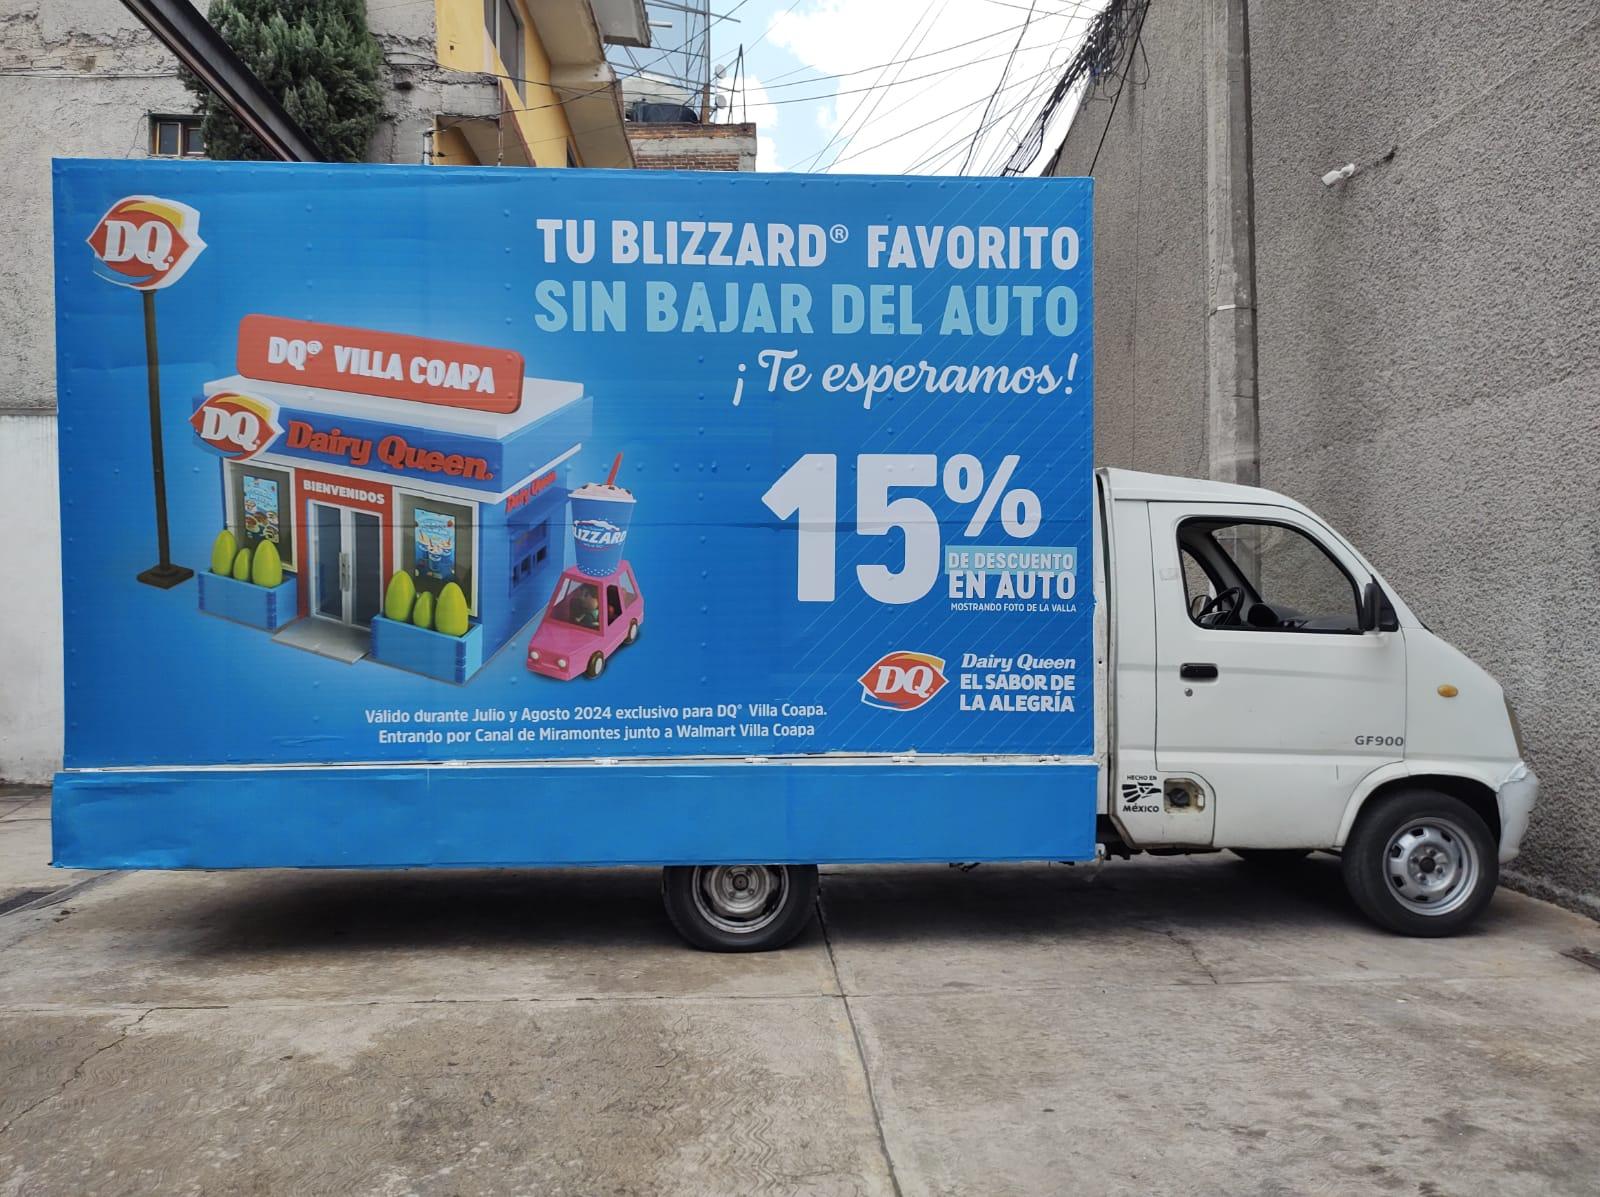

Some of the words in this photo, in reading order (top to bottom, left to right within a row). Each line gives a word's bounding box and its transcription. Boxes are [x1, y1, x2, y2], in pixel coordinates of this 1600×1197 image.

[536, 219, 596, 264] TU
[867, 225, 1080, 270] FAVORITO
[534, 280, 626, 332] SIN
[646, 281, 814, 334] BAJAR
[832, 284, 923, 335] DEL
[939, 286, 1079, 337] AUTO
[334, 345, 403, 381] VILLA
[409, 356, 496, 394] COAPA
[822, 353, 1079, 409] esperamos!
[286, 420, 372, 466] Dairy
[303, 479, 385, 505] BIENVENIDOS
[761, 453, 1042, 605] 15%
[948, 552, 969, 569] DE
[974, 552, 1074, 570] DESCUENTO
[948, 570, 986, 599] EN
[995, 570, 1076, 600] AUTO
[950, 602, 1002, 612] MOSTRANDO
[1003, 603, 1025, 613] FOTO
[1026, 603, 1038, 612] DE
[1039, 603, 1050, 613] LA
[1051, 603, 1077, 613] VALLA
[961, 653, 1013, 671] Dairy
[1016, 653, 1076, 670] Queen
[960, 673, 983, 690] EL
[985, 674, 1047, 691] SABOR
[1050, 674, 1076, 691] DE
[365, 709, 410, 724] Válido
[414, 709, 469, 723] durante
[472, 708, 506, 722] Julio
[509, 711, 518, 723] y
[521, 707, 570, 722] Agosto
[574, 706, 612, 720] 2024
[615, 705, 678, 720] exclusivo
[682, 705, 713, 719] para
[749, 703, 778, 717] Villa
[781, 703, 828, 718] Coapa.
[959, 694, 986, 711] LA
[989, 690, 1075, 713] ALEGRÍA
[378, 729, 443, 743] Entrando
[446, 731, 471, 744] por
[475, 728, 514, 742] Canal
[517, 728, 536, 741] de
[539, 726, 621, 741] Miramontes
[623, 726, 661, 741] junto
[664, 728, 673, 739] a
[676, 724, 736, 738] Walmart
[739, 723, 769, 737] Villa
[773, 723, 815, 738] Coapa
[1354, 735, 1404, 747] GF900
